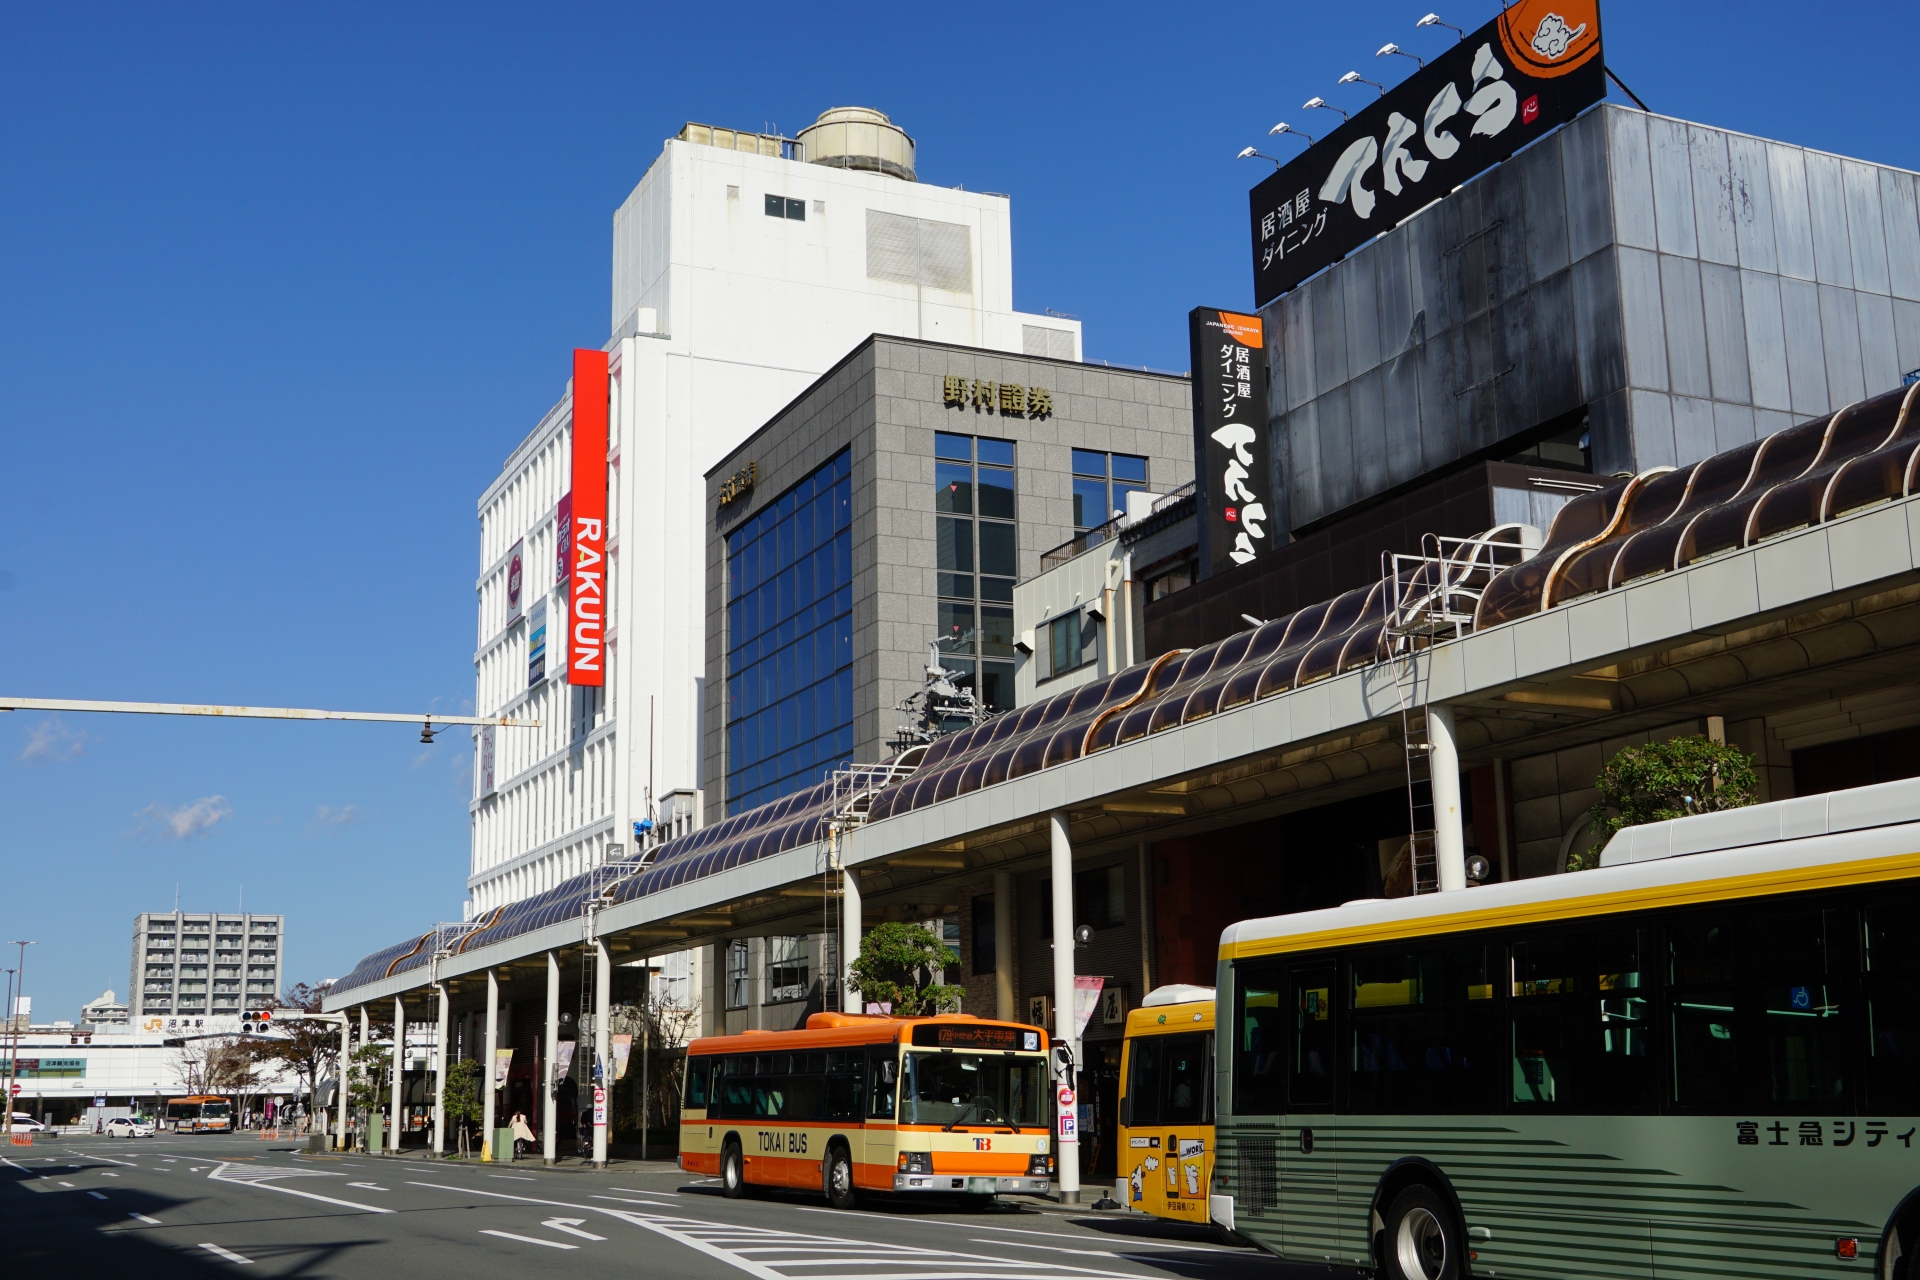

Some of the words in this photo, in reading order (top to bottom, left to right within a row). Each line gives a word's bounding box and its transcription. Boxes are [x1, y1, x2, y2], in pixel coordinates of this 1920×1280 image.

[1261, 188, 1310, 242] 居酒屋
[1262, 207, 1328, 271] ダイニング
[1206, 320, 1235, 330] JAPANESE
[1237, 325, 1260, 333] IZAKAYA
[1223, 328, 1243, 336] DINING
[1220, 344, 1237, 418] ダイニング
[1235, 346, 1251, 399] 居酒屋
[943, 374, 1054, 415] 野村證券
[574, 516, 602, 672] RAKUUN
[168, 1018, 204, 1029] 沼津駅
[973, 1028, 1016, 1043] 大平車庫
[758, 1131, 785, 1152] TOKAI
[789, 1132, 807, 1153] BUS
[1736, 1120, 1916, 1148] 富士急シティ
[1186, 1143, 1204, 1154] WORK
